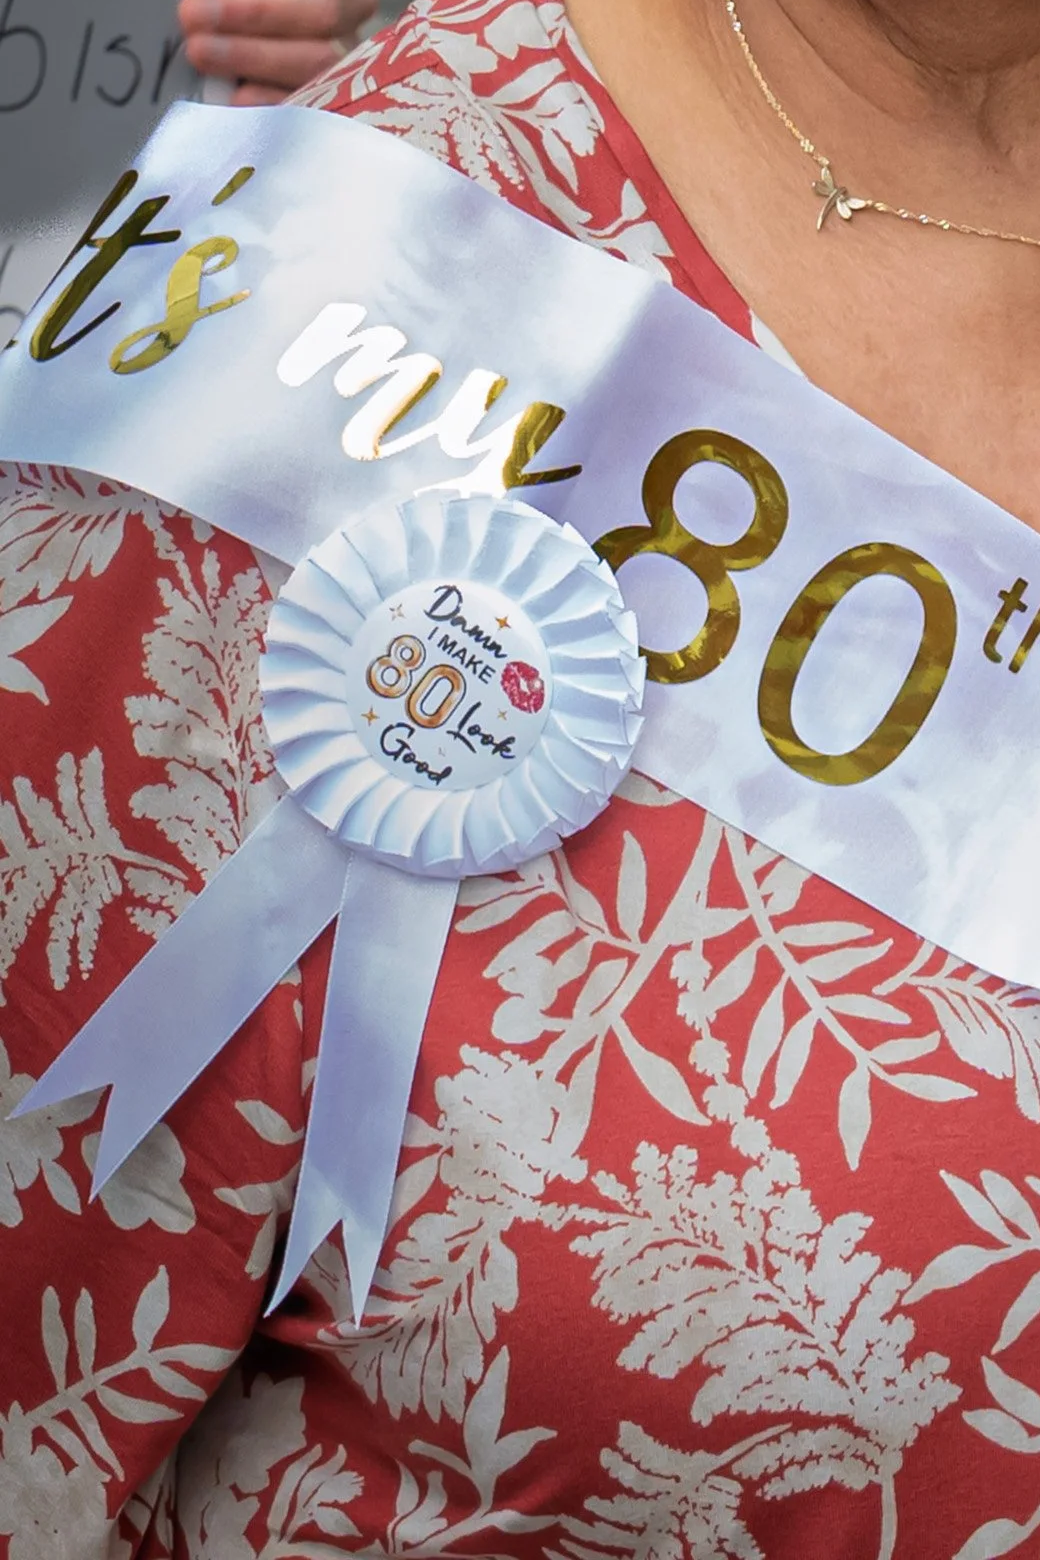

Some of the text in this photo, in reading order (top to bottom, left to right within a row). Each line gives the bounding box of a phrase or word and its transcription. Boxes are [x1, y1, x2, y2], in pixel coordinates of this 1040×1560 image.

[277, 303, 582, 497] my
[423, 585, 508, 659] Damn
[427, 626, 497, 685] I MAKE
[366, 634, 516, 759] 80 Look
[380, 722, 452, 785] Good
